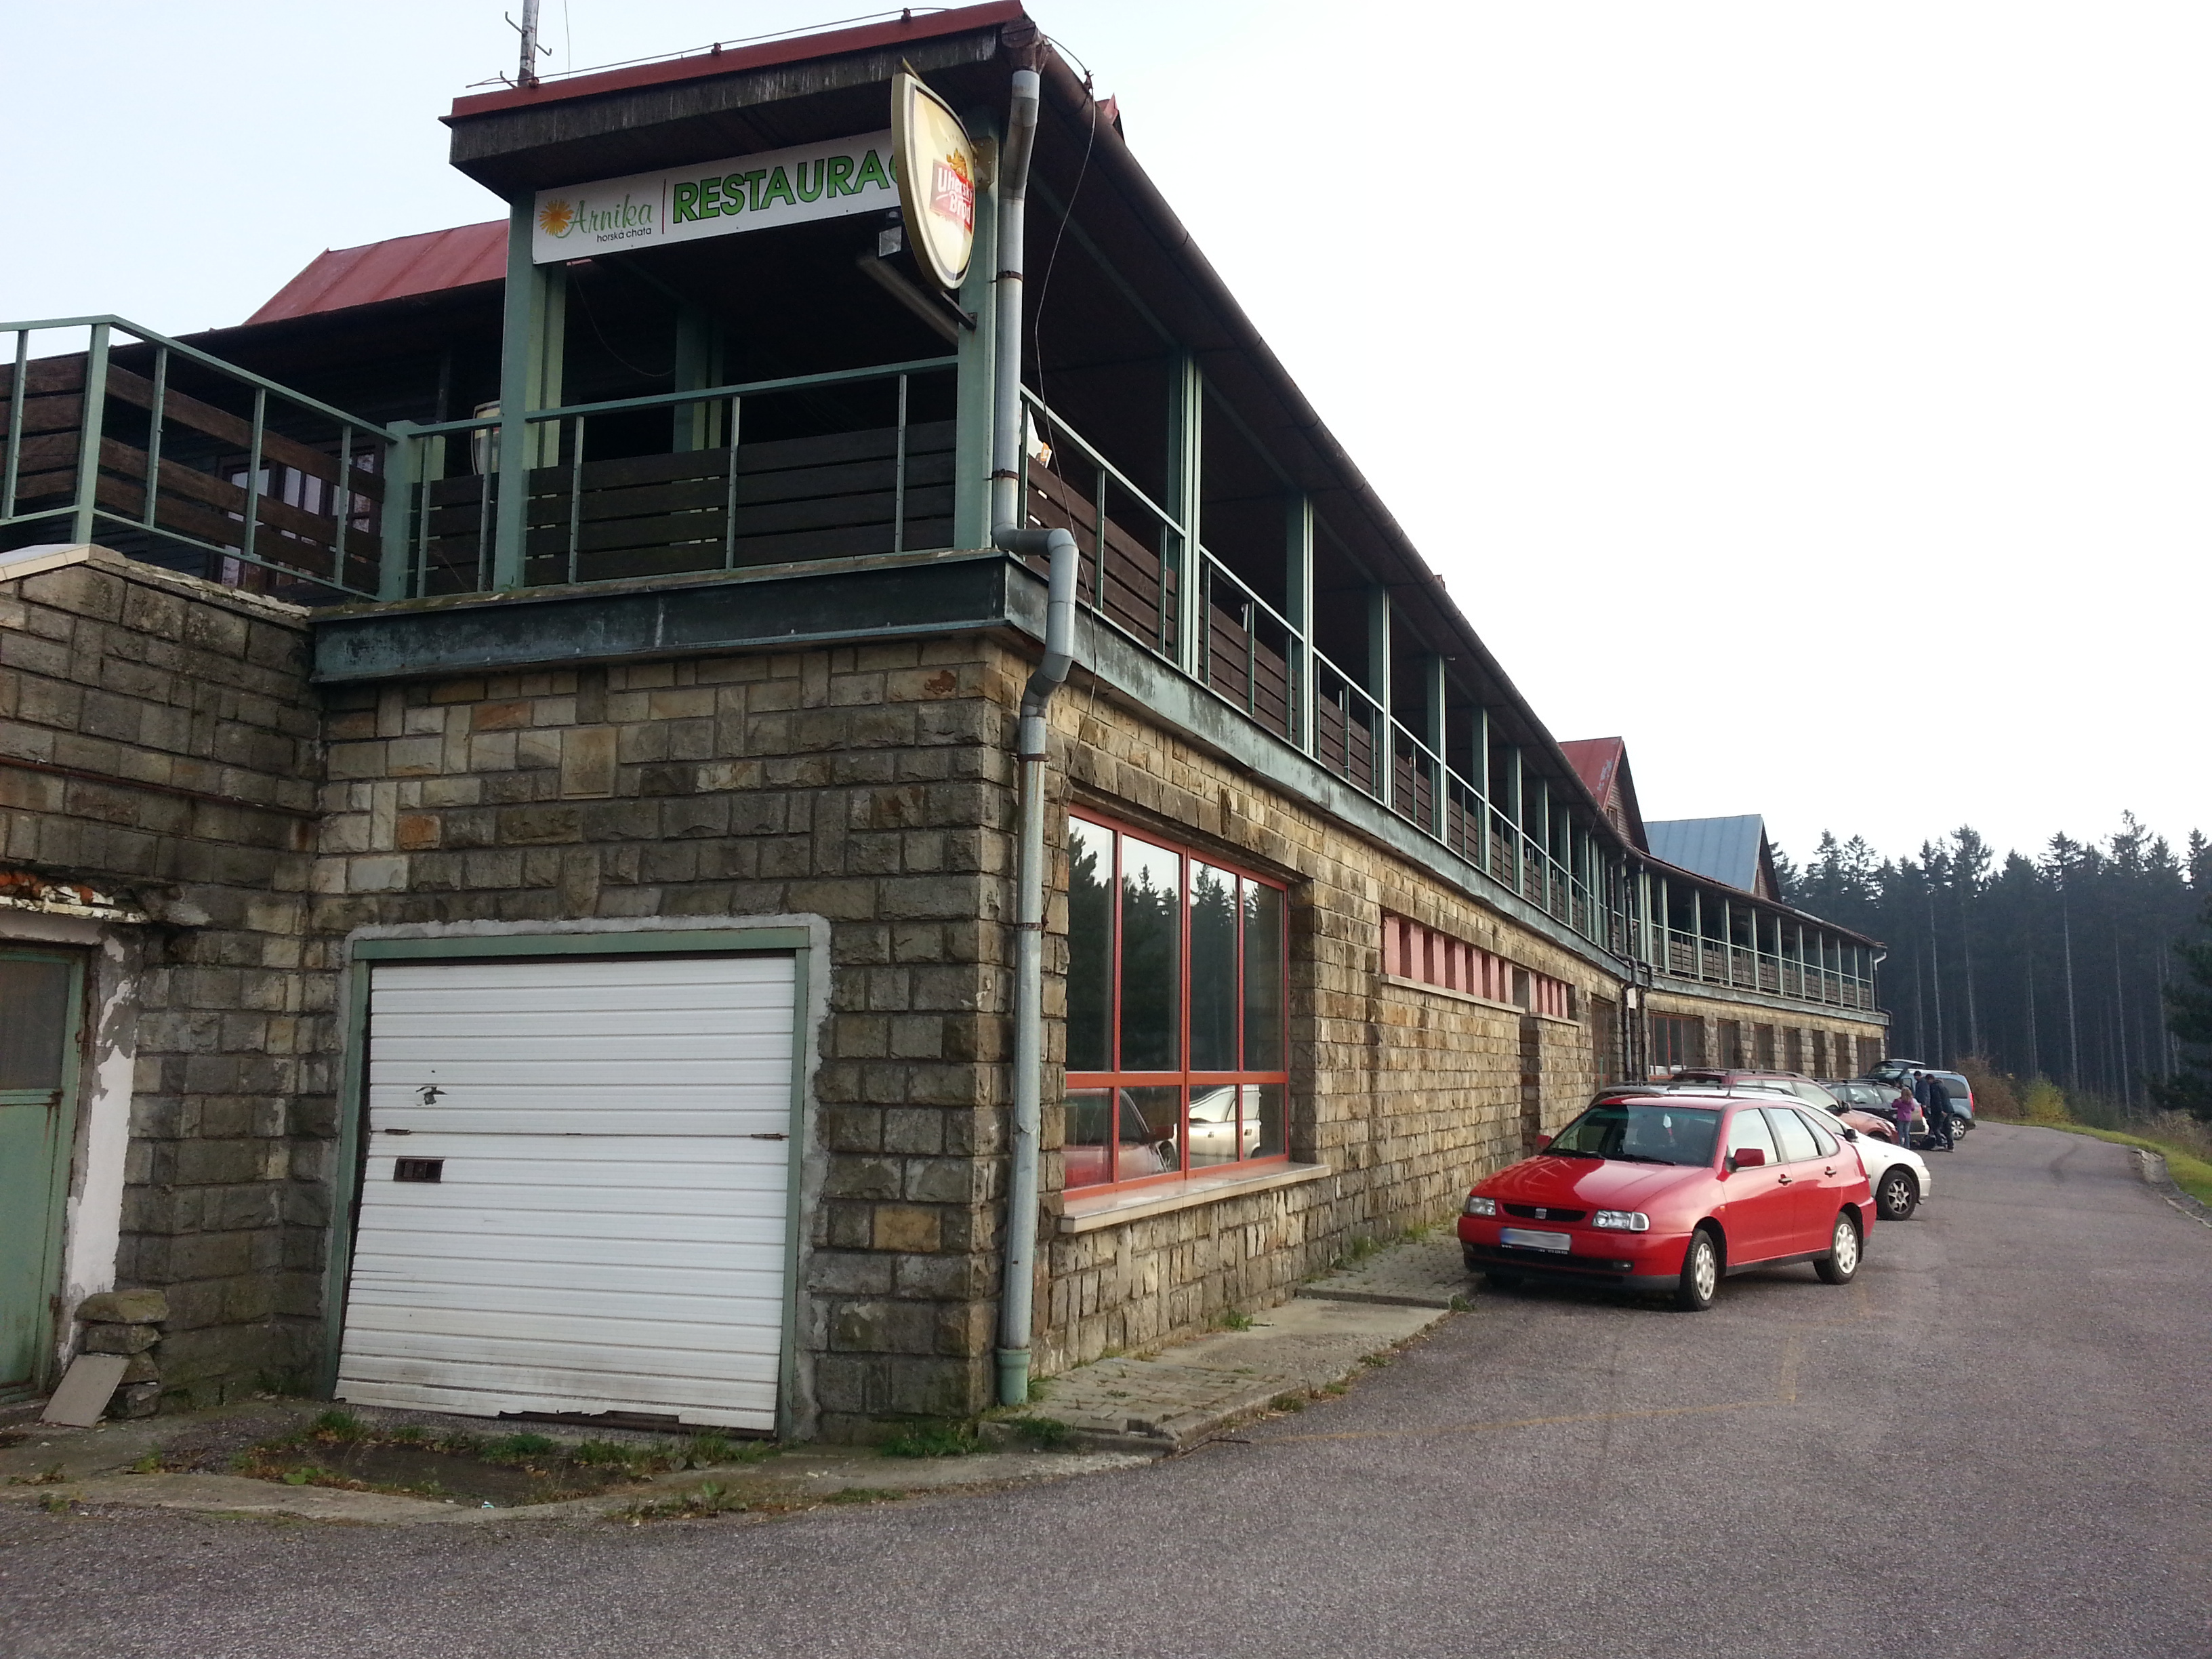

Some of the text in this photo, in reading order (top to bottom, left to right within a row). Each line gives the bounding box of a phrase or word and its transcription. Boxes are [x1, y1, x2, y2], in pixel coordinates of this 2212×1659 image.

[673, 149, 898, 224] RESTAURA
[554, 194, 652, 239] Arnika
[949, 191, 971, 224] Brod
[596, 226, 652, 243] horská chata
